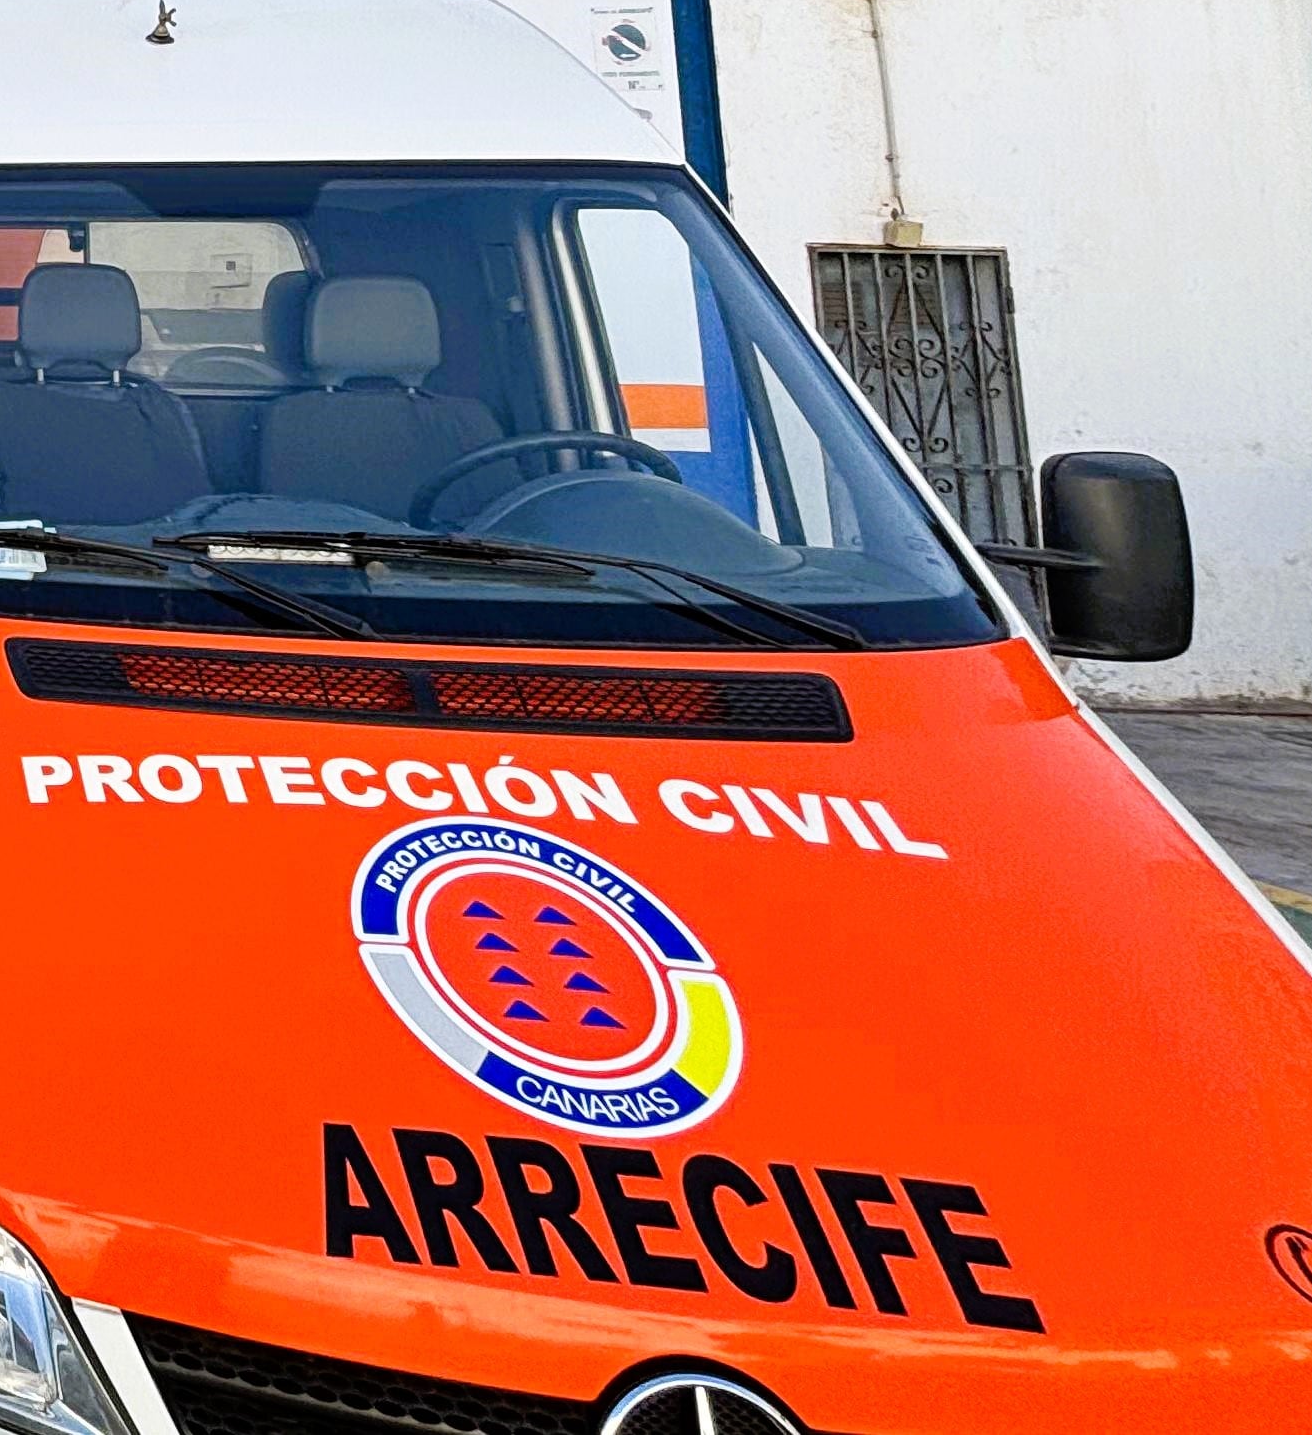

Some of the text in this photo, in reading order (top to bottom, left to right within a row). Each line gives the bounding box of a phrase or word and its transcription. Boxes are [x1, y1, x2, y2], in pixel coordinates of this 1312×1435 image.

[20, 754, 949, 860] PROTECCIÓN CIVIL
[375, 829, 639, 913] PROTECCIÓN CIVIL
[515, 1074, 680, 1125] CANARIAS
[323, 1122, 1046, 1335] ARRECIFE
